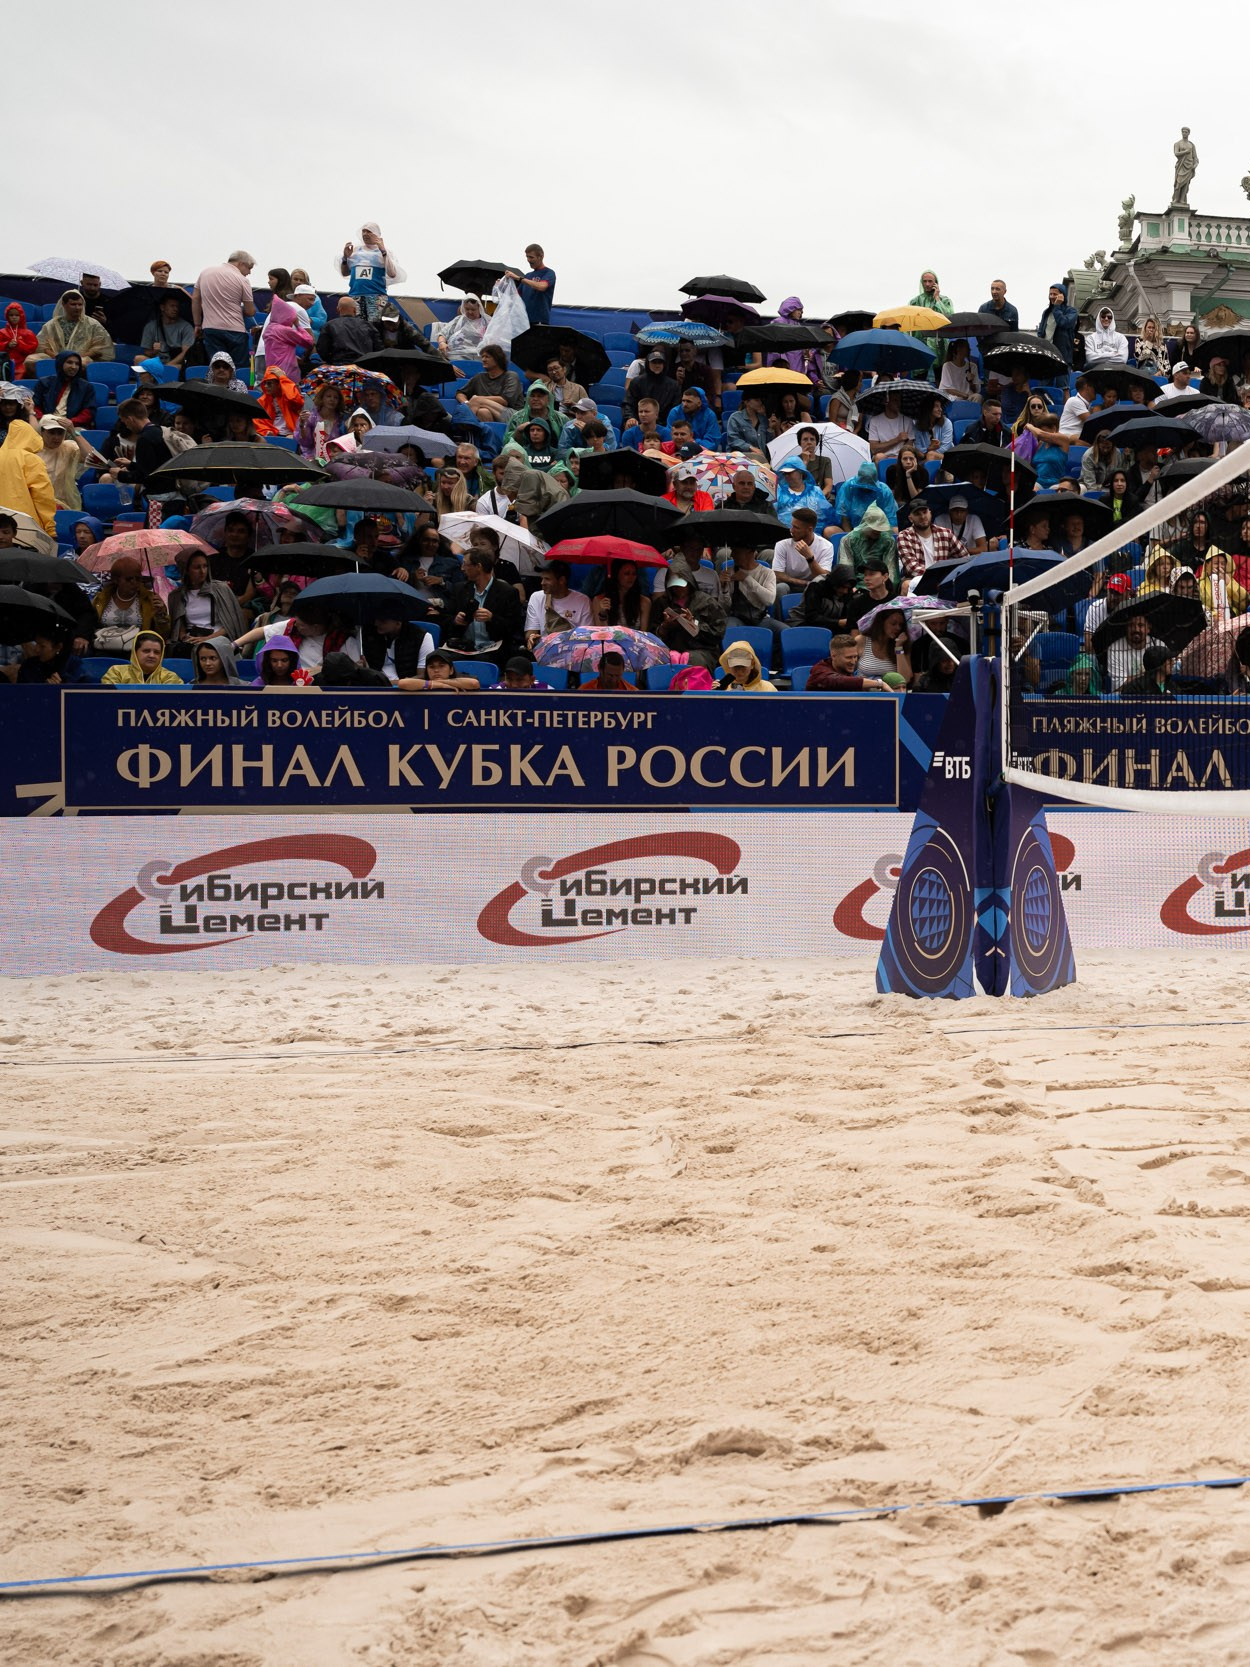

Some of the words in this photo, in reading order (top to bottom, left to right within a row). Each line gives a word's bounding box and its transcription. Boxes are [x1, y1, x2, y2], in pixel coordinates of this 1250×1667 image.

[117, 704, 258, 728] ПЛЯЖНЫЙ
[267, 705, 405, 729] ВОЛЕЙБОЛ
[447, 708, 658, 730] САНКТ-ПЕТЕРБУРГ
[1032, 713, 1147, 734] ПЛЯЖНЫЙ
[116, 743, 365, 789] ФИНАЛ
[388, 744, 586, 790] КУБКА
[607, 745, 856, 788] РОССИИ
[945, 756, 971, 779] ВТБ
[1033, 748, 1234, 788] ФИНАЛ
[159, 904, 330, 935] Цемент
[541, 898, 698, 927] Цемент
